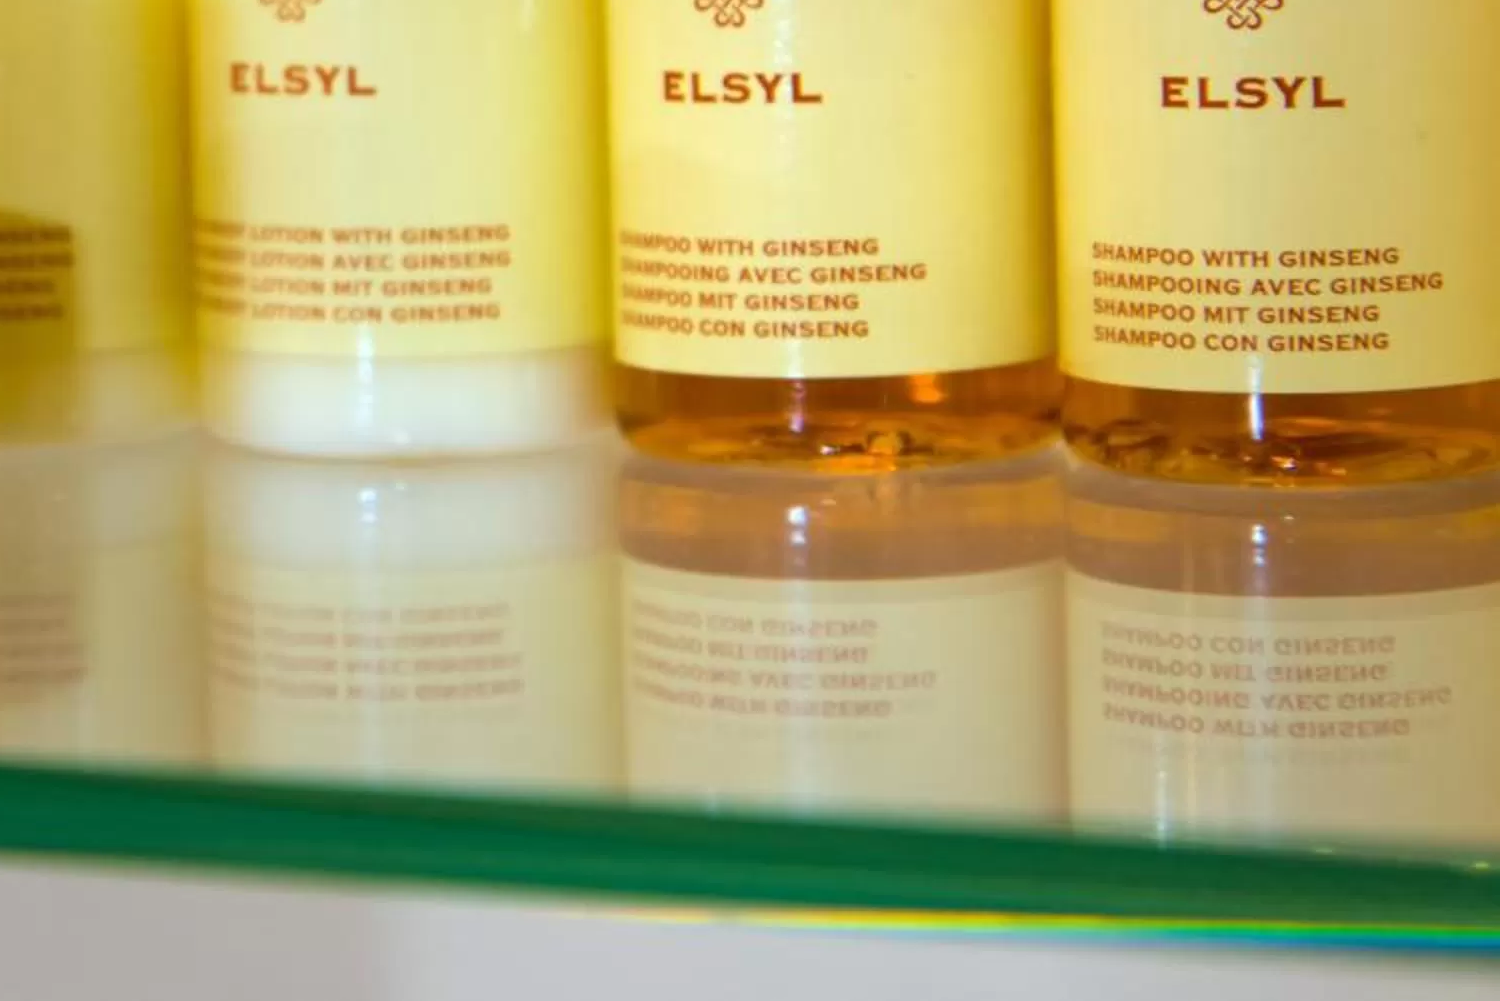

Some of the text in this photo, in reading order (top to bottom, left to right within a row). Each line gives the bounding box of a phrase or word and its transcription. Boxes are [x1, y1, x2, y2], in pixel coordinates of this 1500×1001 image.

[231, 63, 377, 96] ELSYL
[662, 71, 823, 103] ELSYL
[1161, 76, 1346, 108] ELSYL
[332, 228, 392, 245] WITH
[400, 224, 510, 244] GINSENG
[698, 238, 754, 256] WITH
[762, 238, 879, 257] GINSENG
[1092, 241, 1400, 268] SHAMPOO WITH GINSENG
[333, 254, 393, 271] AVEC
[402, 251, 511, 270] GINSENG
[739, 267, 802, 284] AVEC
[811, 263, 927, 285] GINSENG
[1093, 270, 1444, 296] SHAMPOOING AVEC GINSENG
[333, 280, 373, 296] MIT
[382, 278, 492, 297] GINSENG
[699, 291, 736, 310] MIT
[744, 293, 860, 311] GINSENG
[1093, 297, 1380, 324] SHAMPOO MIT GINSENG
[332, 306, 382, 322] CON
[391, 303, 500, 323] GINSENG
[700, 318, 746, 337] CON
[754, 319, 870, 338] GINSENG
[1094, 324, 1390, 352] SHAMPOO CON GINSENG
